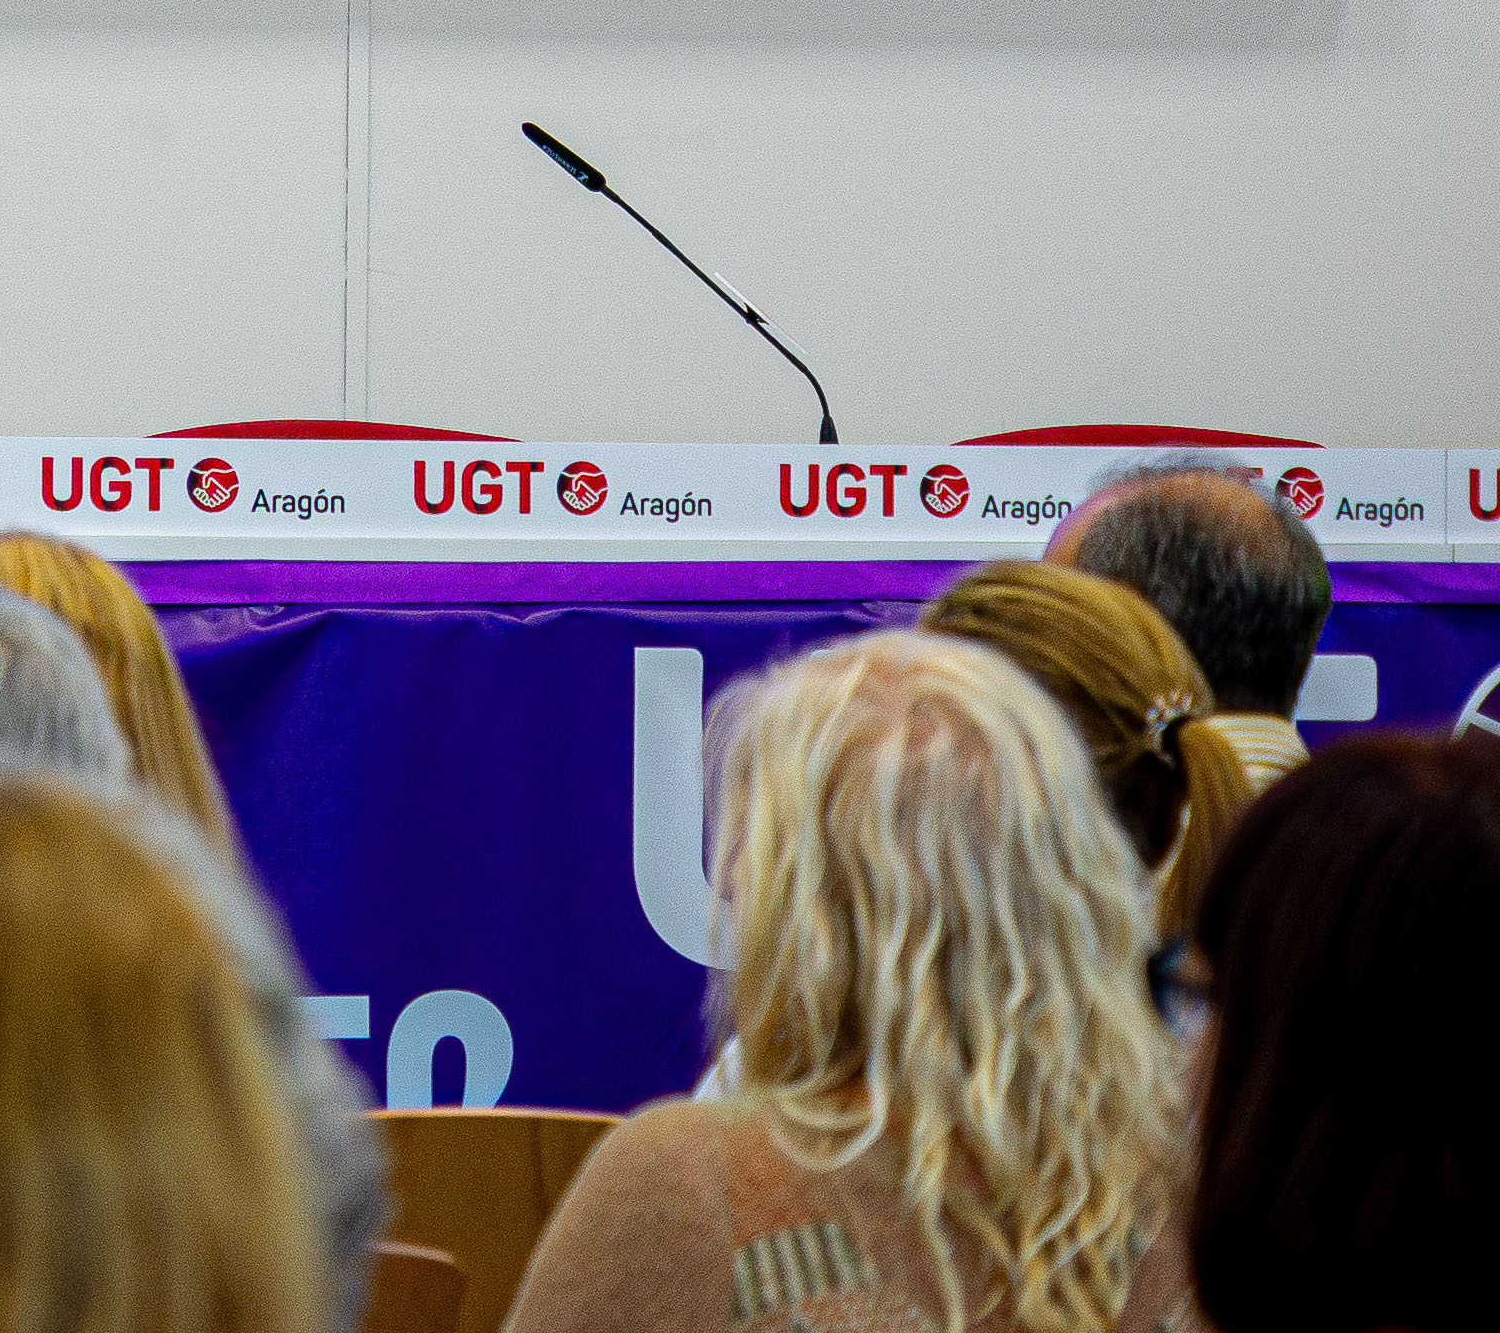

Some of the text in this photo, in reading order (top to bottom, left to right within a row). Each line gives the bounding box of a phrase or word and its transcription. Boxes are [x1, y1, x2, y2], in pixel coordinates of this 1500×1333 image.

[41, 456, 345, 520] UGT Aragón
[413, 460, 712, 523] UGT Aragón
[779, 463, 1072, 525] UGT Aragón
[1336, 497, 1424, 527] Aragón
